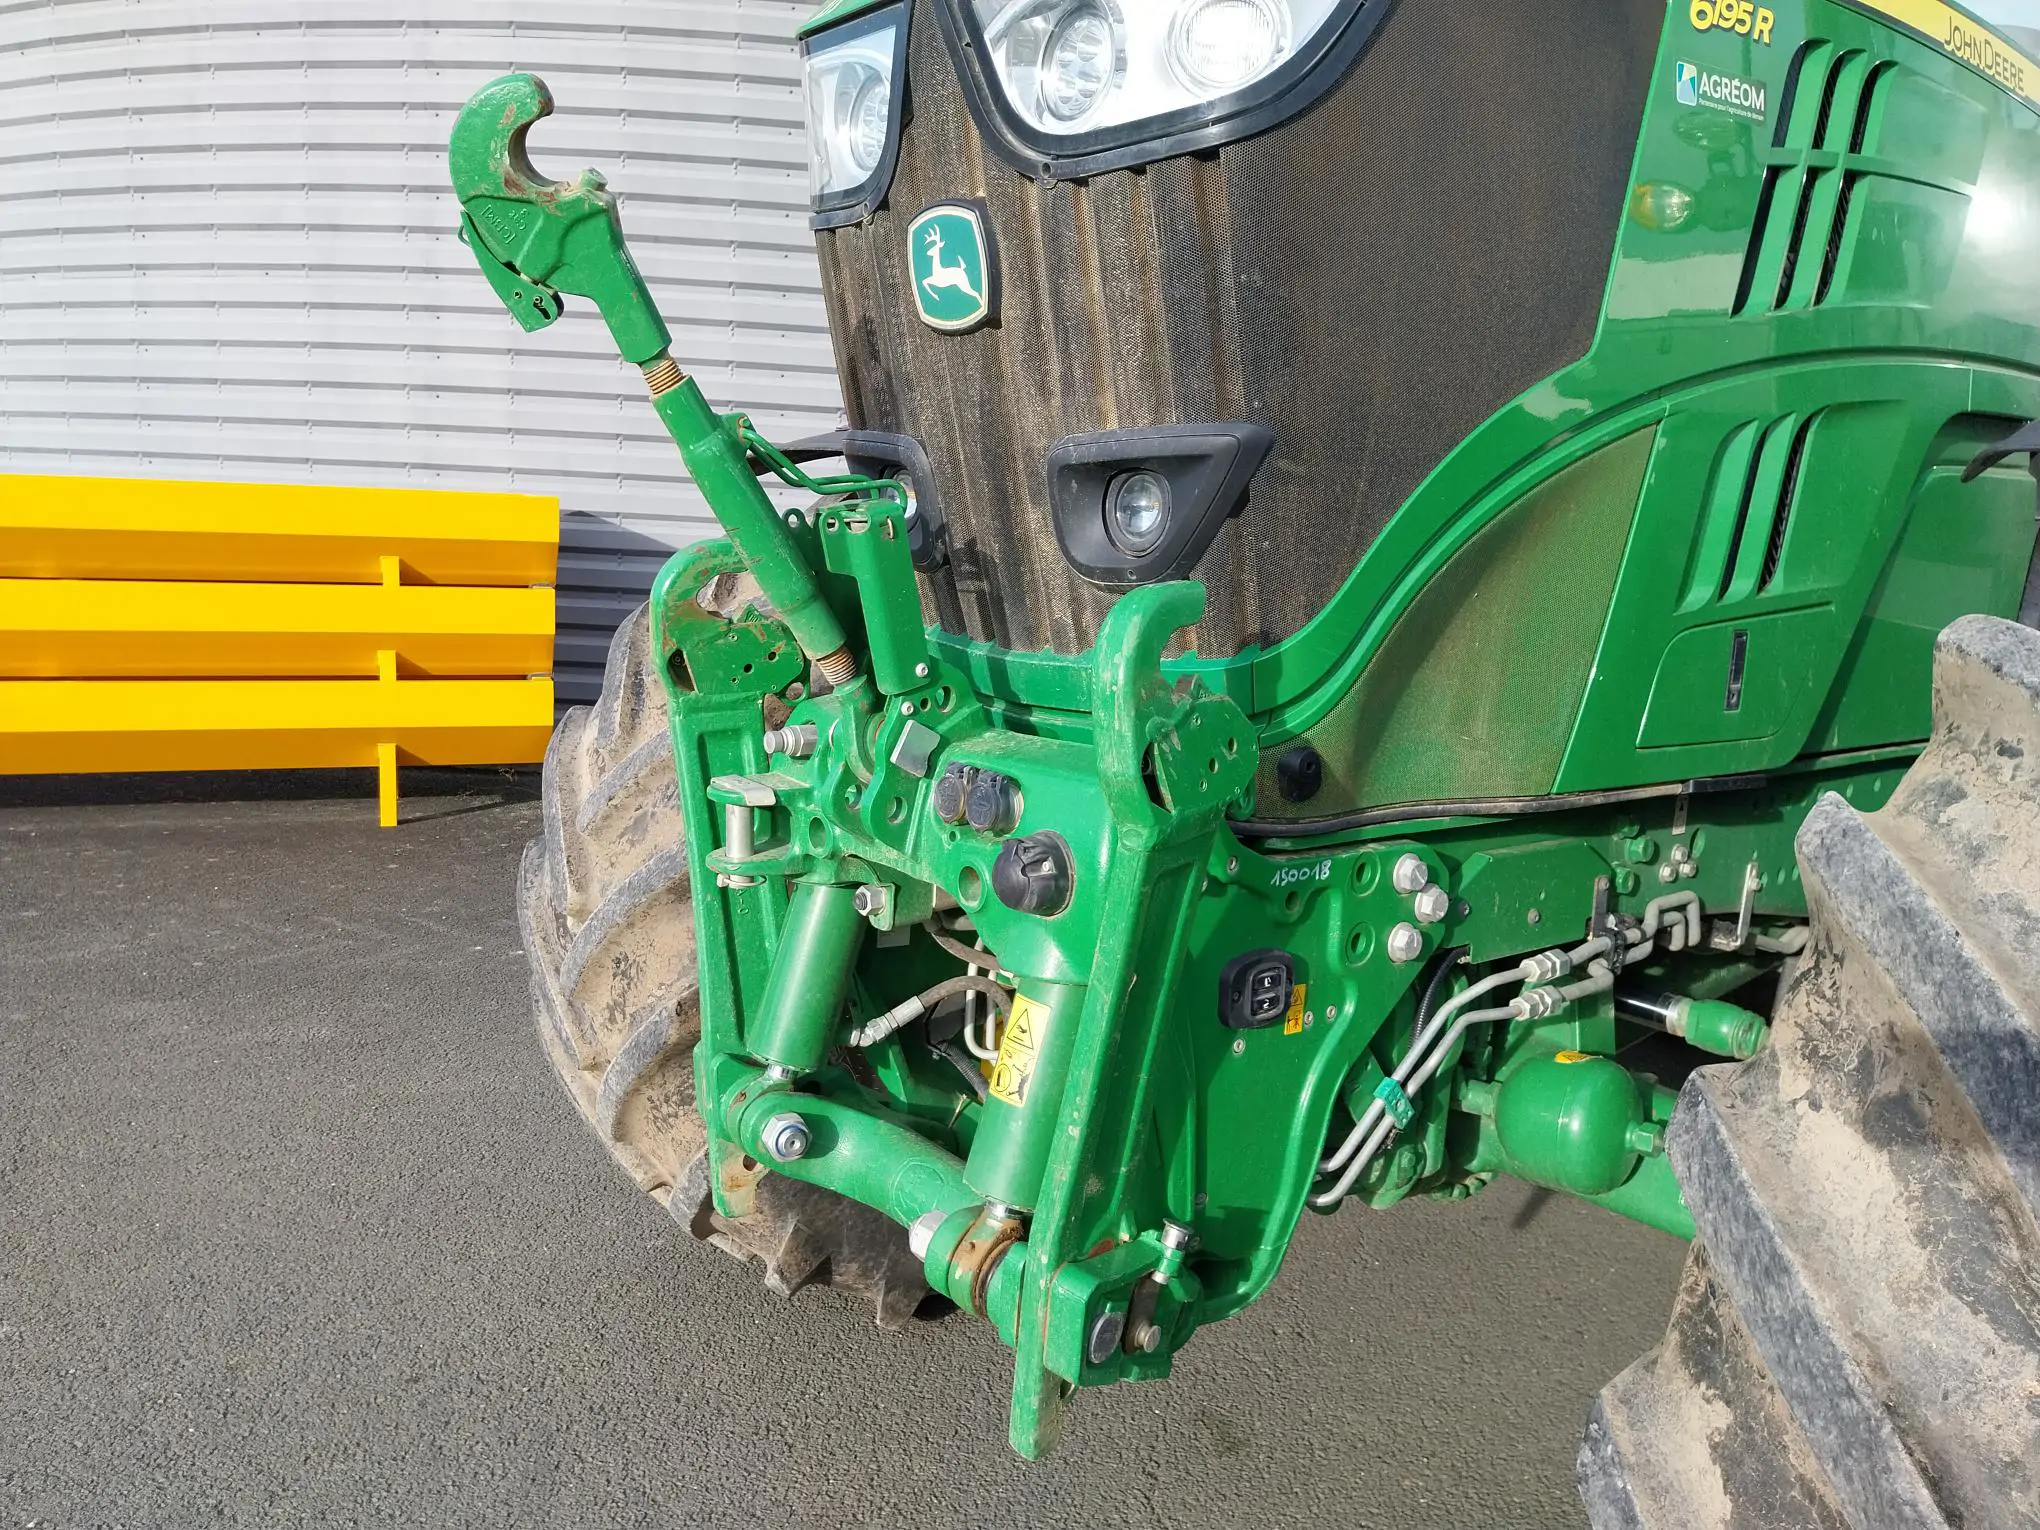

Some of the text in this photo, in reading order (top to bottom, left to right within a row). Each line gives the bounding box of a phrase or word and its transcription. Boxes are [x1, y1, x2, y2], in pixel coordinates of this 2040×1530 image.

[1944, 15, 2025, 93] JOHN DEERE
[1698, 71, 1765, 112] AGRÉOM
[1270, 859, 1332, 887] 150018
